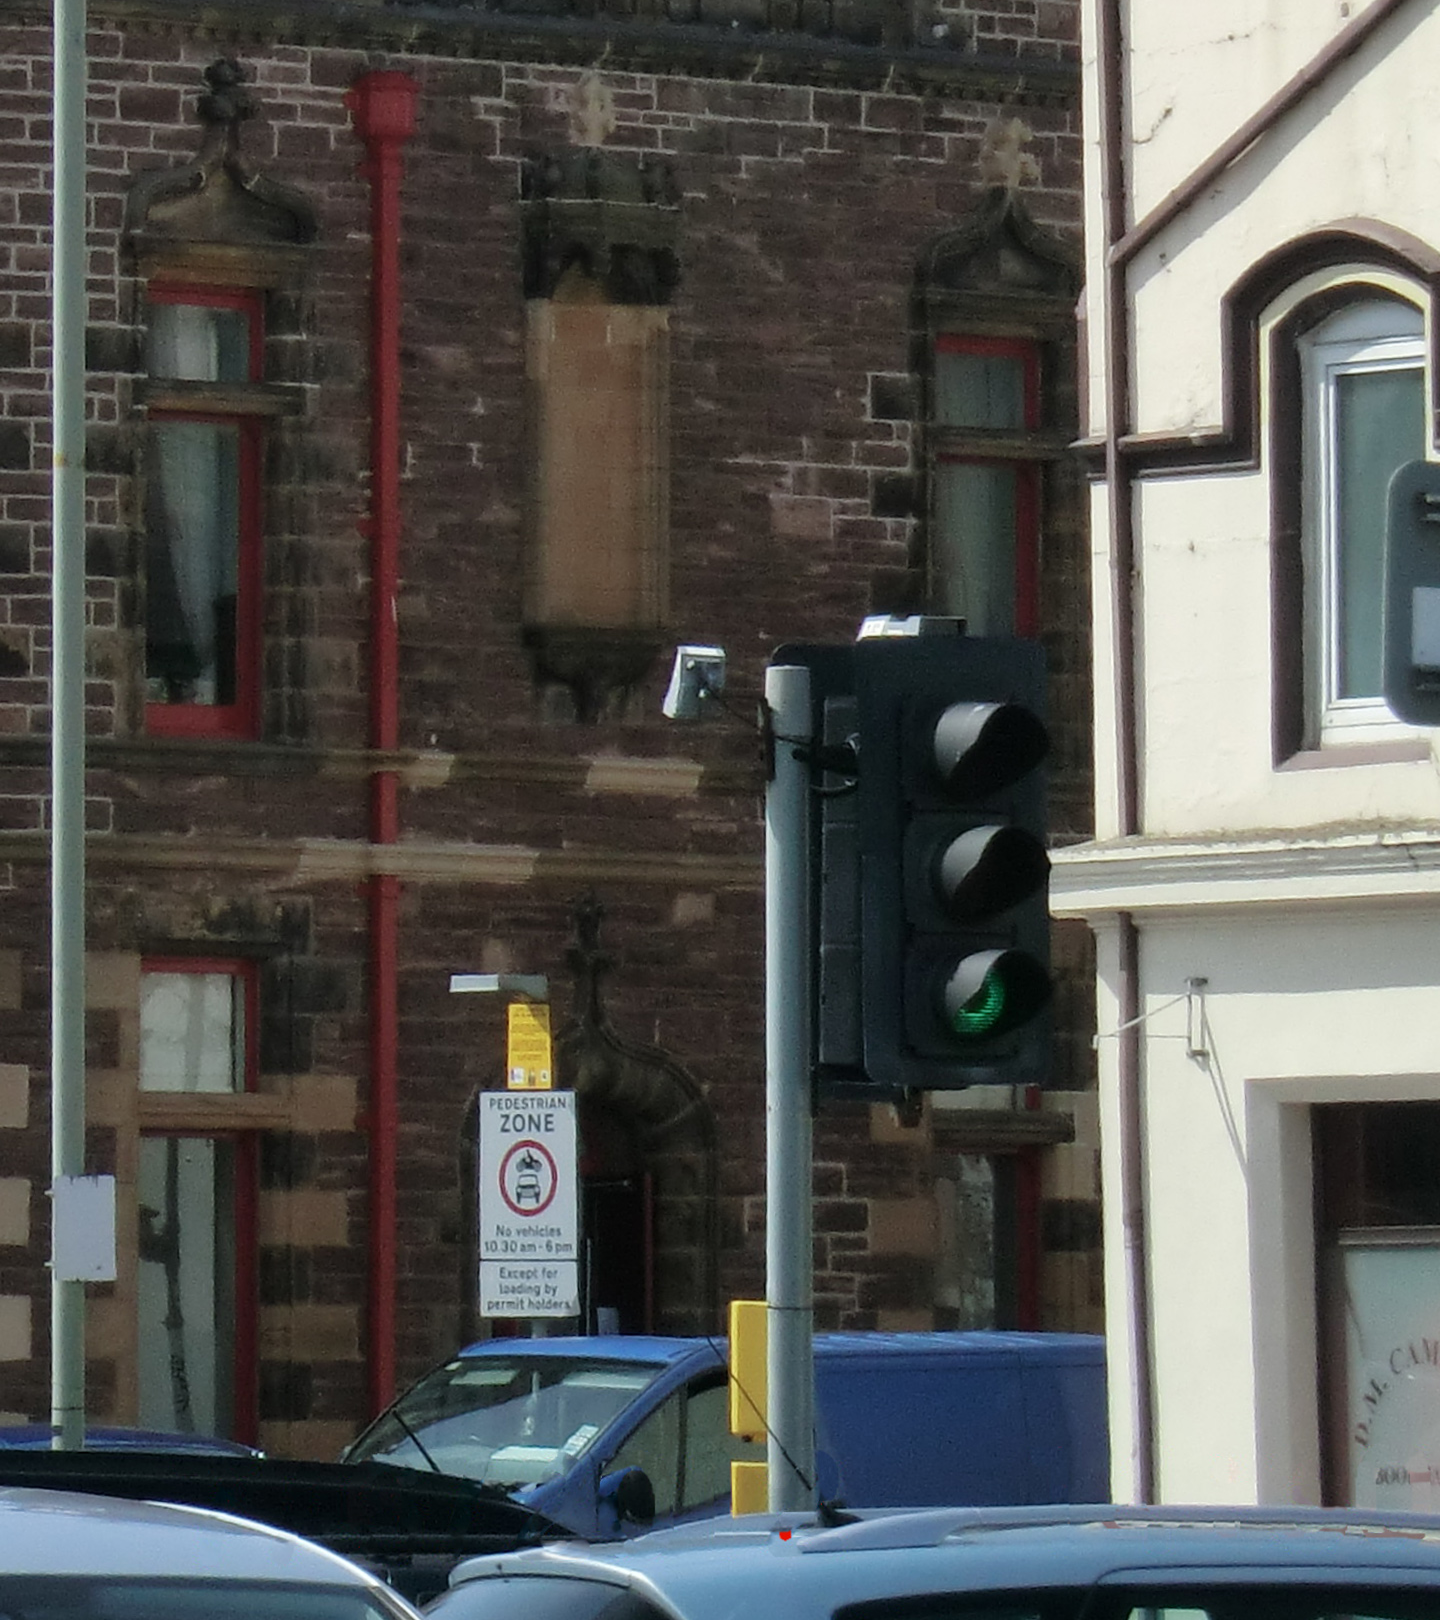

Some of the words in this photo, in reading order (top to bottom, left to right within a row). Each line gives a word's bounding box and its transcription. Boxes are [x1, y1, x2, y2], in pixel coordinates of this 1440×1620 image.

[489, 1097, 567, 1111] PEDESTRIAN
[500, 1113, 555, 1133] ZONE
[496, 1224, 512, 1237] No
[516, 1225, 562, 1237] vehicles
[500, 1267, 538, 1280] Except
[542, 1267, 558, 1279] for
[499, 1283, 541, 1297] loading
[544, 1283, 558, 1297] by
[487, 1297, 524, 1311] permit
[528, 1297, 571, 1310] holders
